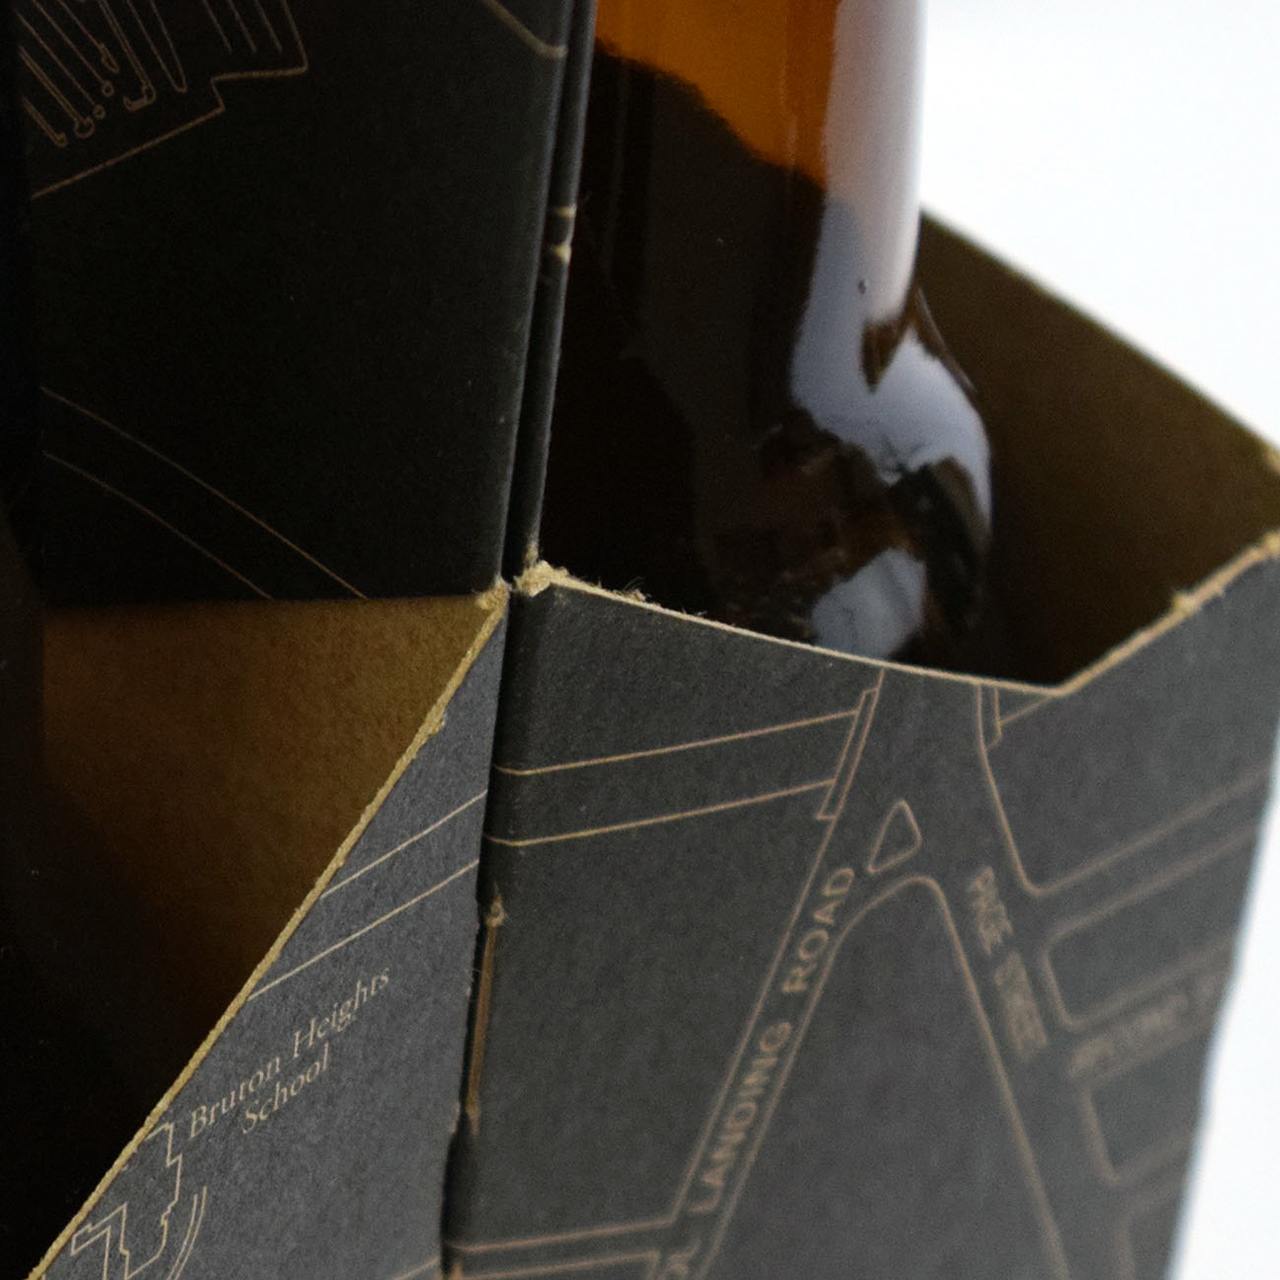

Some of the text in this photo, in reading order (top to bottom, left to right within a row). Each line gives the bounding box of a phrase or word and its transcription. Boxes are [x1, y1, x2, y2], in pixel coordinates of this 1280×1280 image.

[189, 965, 392, 1141] Bruton Heights
[242, 1042, 331, 1133] School
[691, 1018, 792, 1216] LANDING
[782, 865, 856, 996] ROAD
